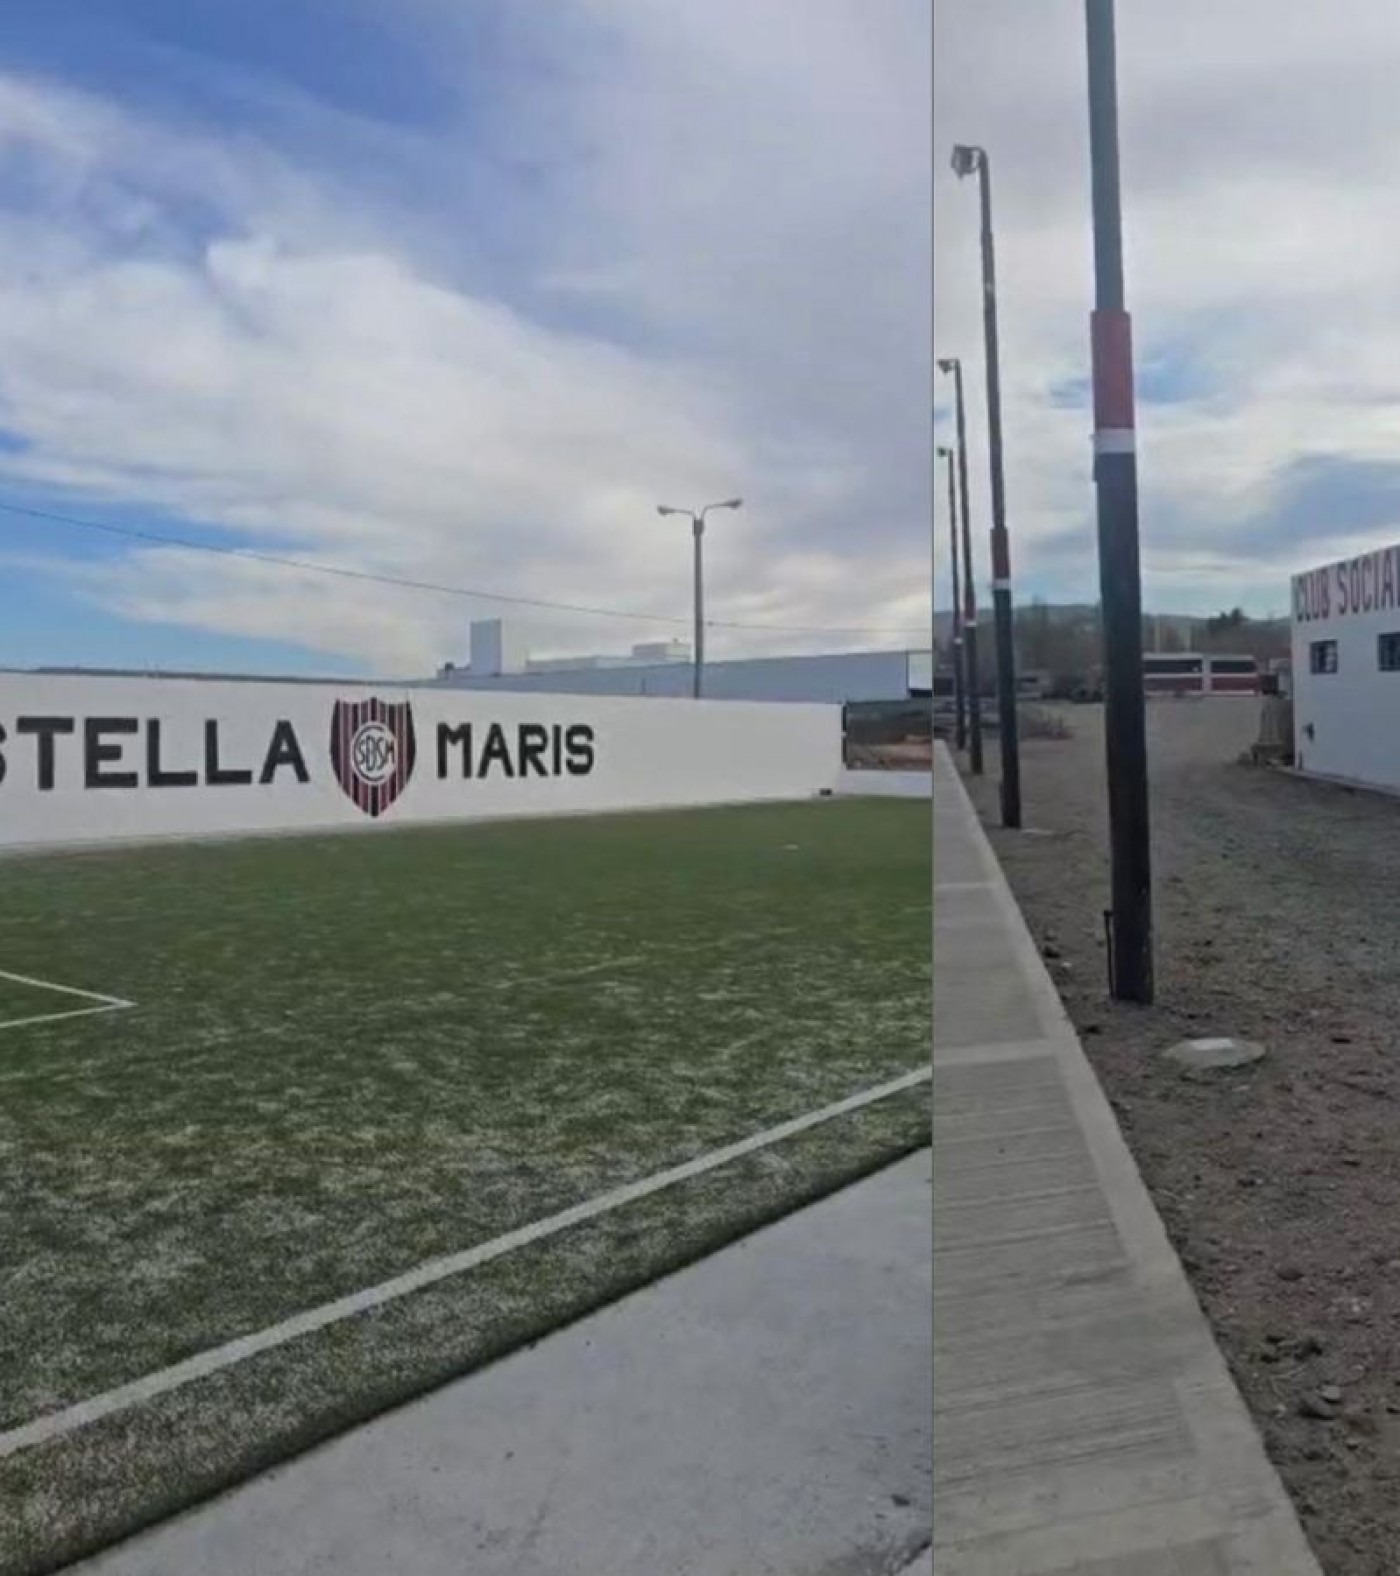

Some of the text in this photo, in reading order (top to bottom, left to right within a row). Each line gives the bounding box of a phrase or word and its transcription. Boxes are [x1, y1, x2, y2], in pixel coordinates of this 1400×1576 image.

[1295, 567, 1331, 622] CLUB
[0, 715, 595, 791] TELLA MARIS
